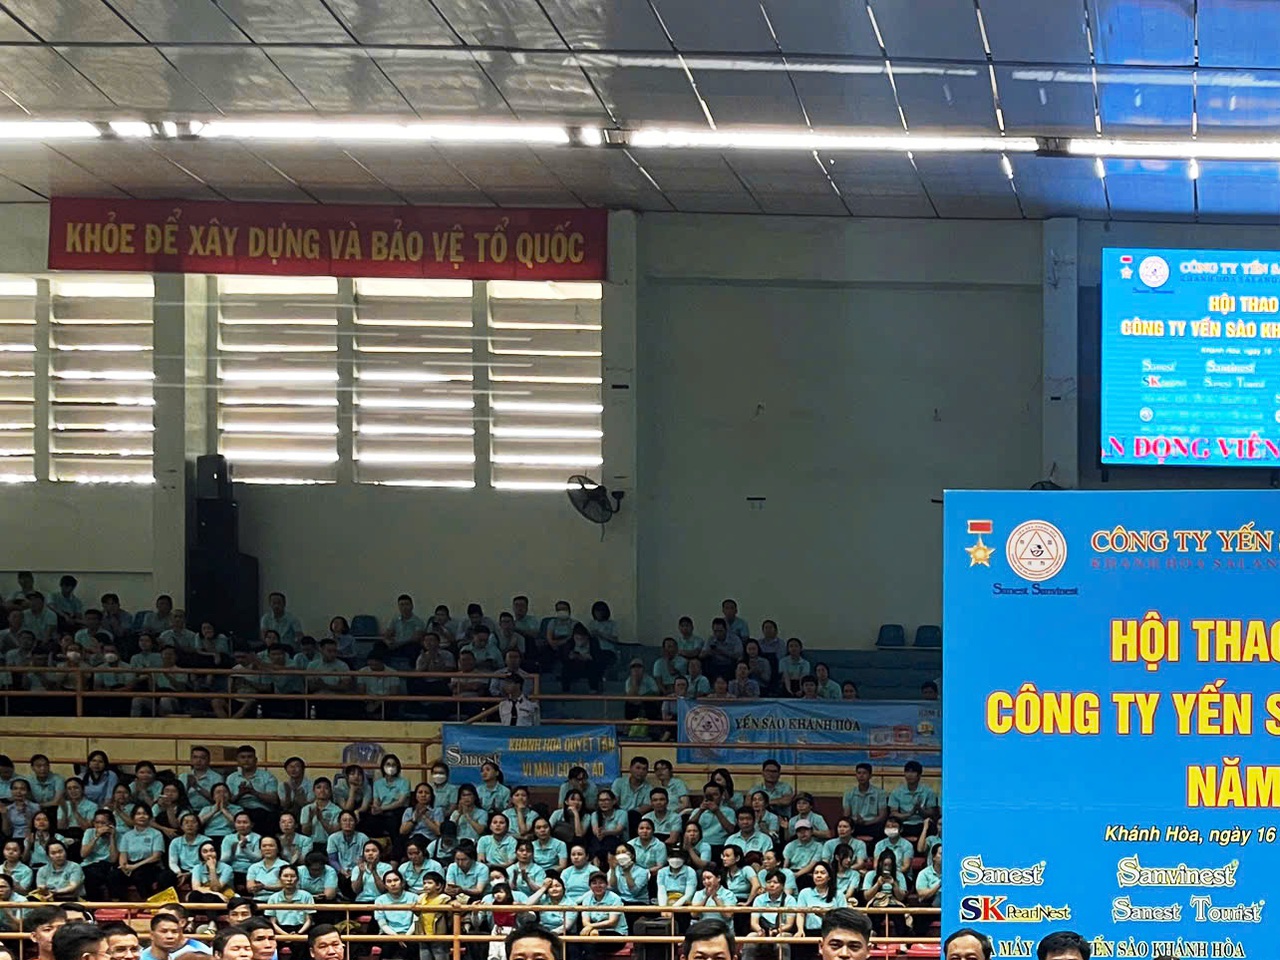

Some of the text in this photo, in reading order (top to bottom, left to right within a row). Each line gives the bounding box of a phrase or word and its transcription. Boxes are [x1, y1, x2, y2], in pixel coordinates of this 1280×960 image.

[66, 208, 584, 269] KHỎE ĐỂ XÂY DỰNG VÀ BẢO VỆ TỔ QUỐC
[1220, 262, 1239, 275] TY
[1209, 292, 1235, 315] HỘI
[1240, 296, 1279, 313] THAO
[1120, 316, 1164, 336] CÔNG
[1168, 320, 1187, 337] TY
[1134, 435, 1210, 465] ĐỘNG
[1217, 431, 1280, 461] VIÊN
[1091, 524, 1169, 554] CÔNG
[1174, 530, 1211, 553] TY
[1216, 521, 1274, 553] YẾN
[1110, 611, 1181, 672] HỘI
[986, 682, 1101, 736] CÔNG
[1112, 692, 1168, 735] TY
[1172, 679, 1252, 736] YẾN
[1104, 825, 1160, 842] Khánh
[1165, 825, 1203, 845] Hòa,
[1209, 826, 1251, 847] ngày
[1257, 827, 1276, 843] 16
[960, 854, 1046, 888] Sanest
[1117, 853, 1239, 888] Sanvinest
[1112, 895, 1265, 923] Sanest Tourist
[999, 936, 1034, 957] MÁY
[1118, 936, 1148, 957] SÀO
[1152, 937, 1207, 958] KHÁNH
[1213, 937, 1246, 958] HÒA
